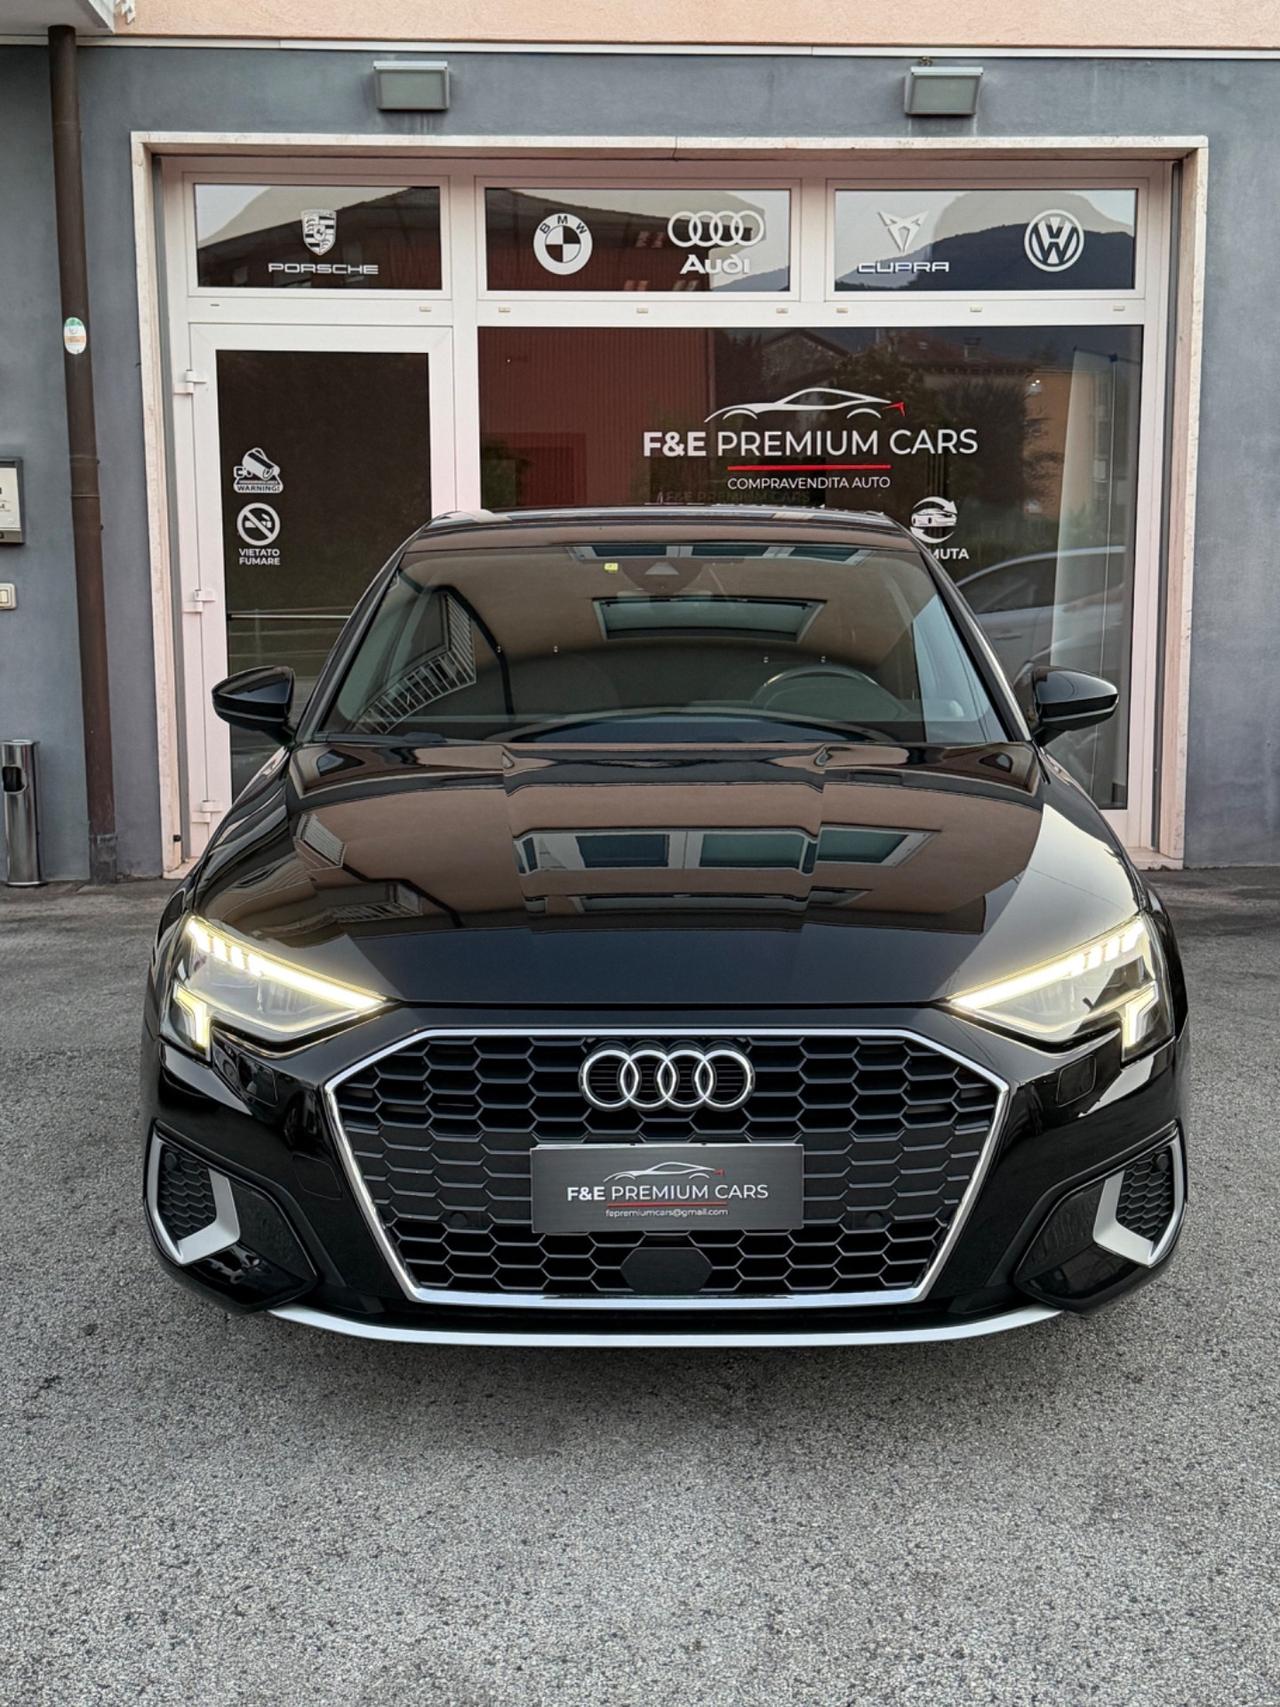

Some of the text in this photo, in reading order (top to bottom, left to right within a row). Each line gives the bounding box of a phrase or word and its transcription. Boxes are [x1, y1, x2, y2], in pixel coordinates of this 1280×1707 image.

[268, 263, 379, 275] PORSCHE
[679, 253, 750, 275] Audi
[857, 260, 949, 273] CUPRA
[643, 428, 978, 457] F&E PREMIUM CARS
[727, 476, 891, 490] COMPRAVENDITA AUTO
[238, 548, 280, 557] VIETATO
[239, 557, 280, 566] FUMARE
[567, 1184, 769, 1201] F&E PREMIUM CARS
[605, 1207, 729, 1219] fepremiumcars@gmail.com
